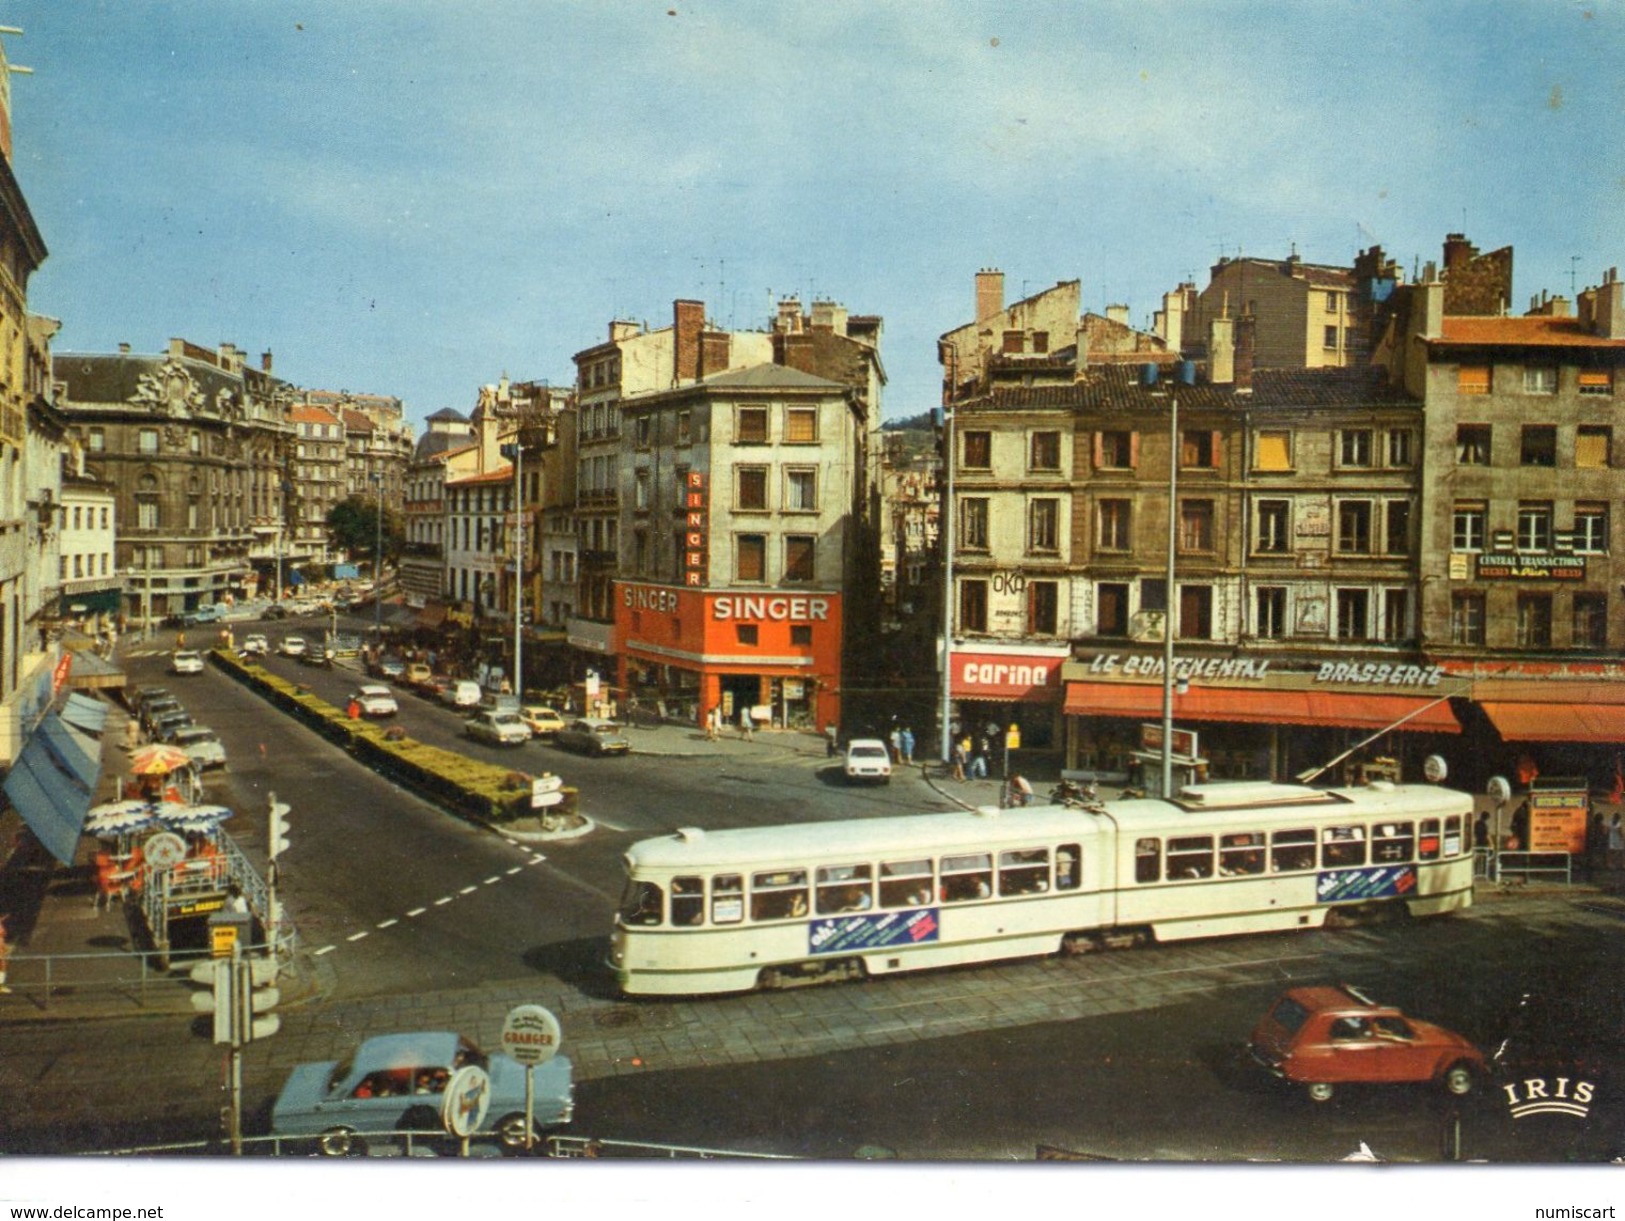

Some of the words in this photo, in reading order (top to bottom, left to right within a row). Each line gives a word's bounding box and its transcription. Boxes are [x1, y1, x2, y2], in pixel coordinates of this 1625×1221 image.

[690, 474, 701, 585] SINGER
[993, 570, 1025, 596] OKA
[624, 588, 678, 613] SINGER
[713, 597, 829, 621] SINGER
[963, 661, 1048, 686] carina
[1090, 654, 1119, 674] LE
[504, 1032, 553, 1045] GRANGER
